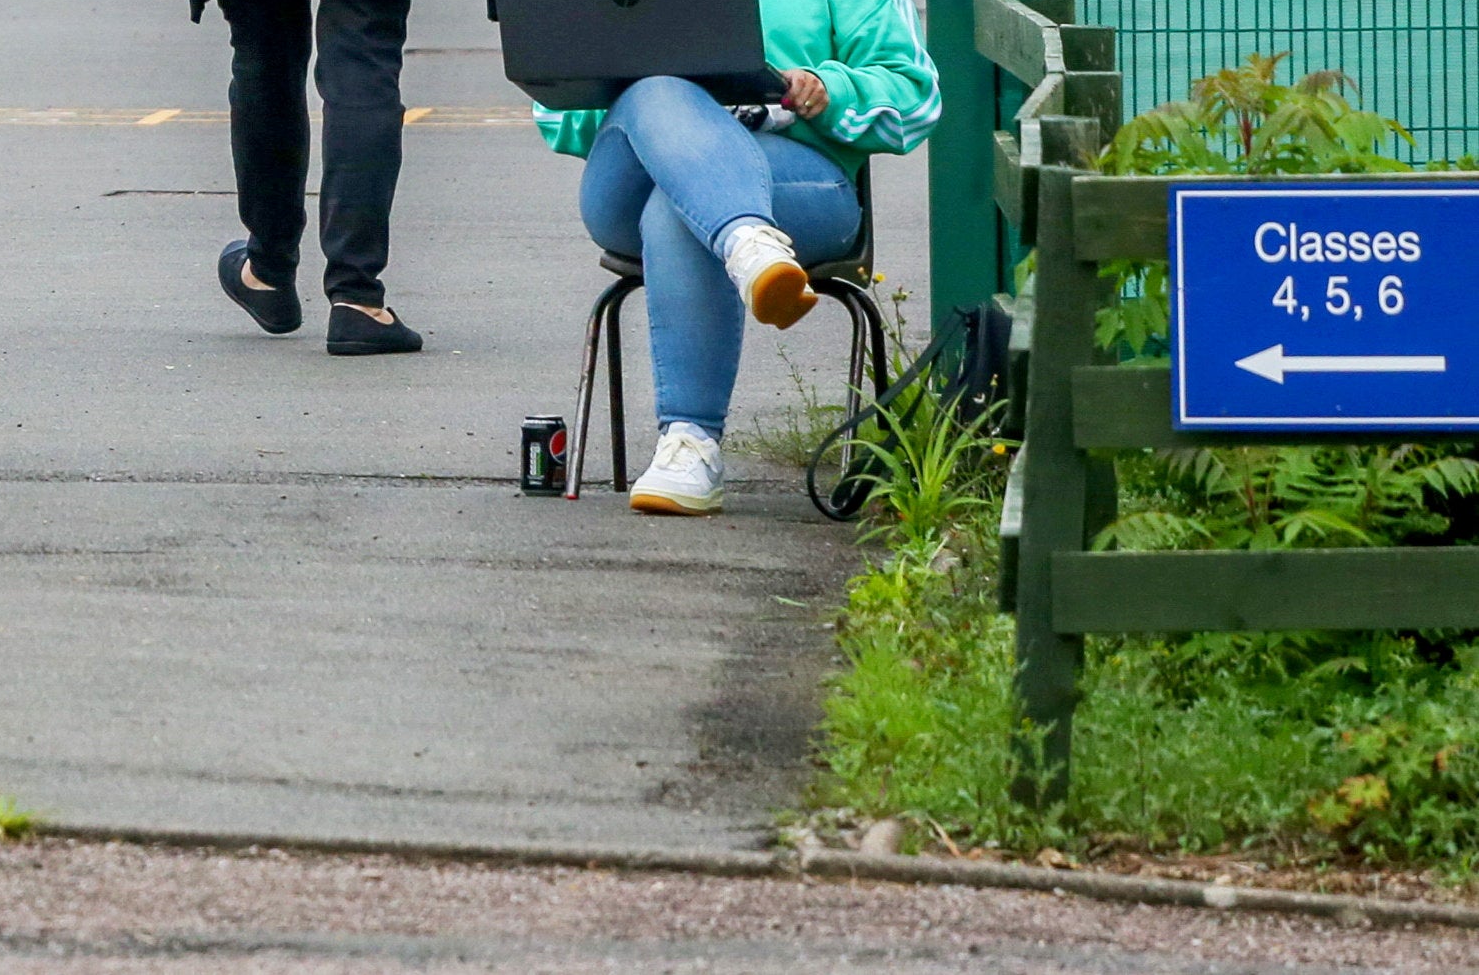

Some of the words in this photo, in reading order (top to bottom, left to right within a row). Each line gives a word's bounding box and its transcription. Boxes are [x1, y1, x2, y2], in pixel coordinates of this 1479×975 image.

[1254, 222, 1421, 263] Classes
[1272, 275, 1310, 322] 4,
[1325, 275, 1363, 322] 5,
[1378, 275, 1405, 315] 6
